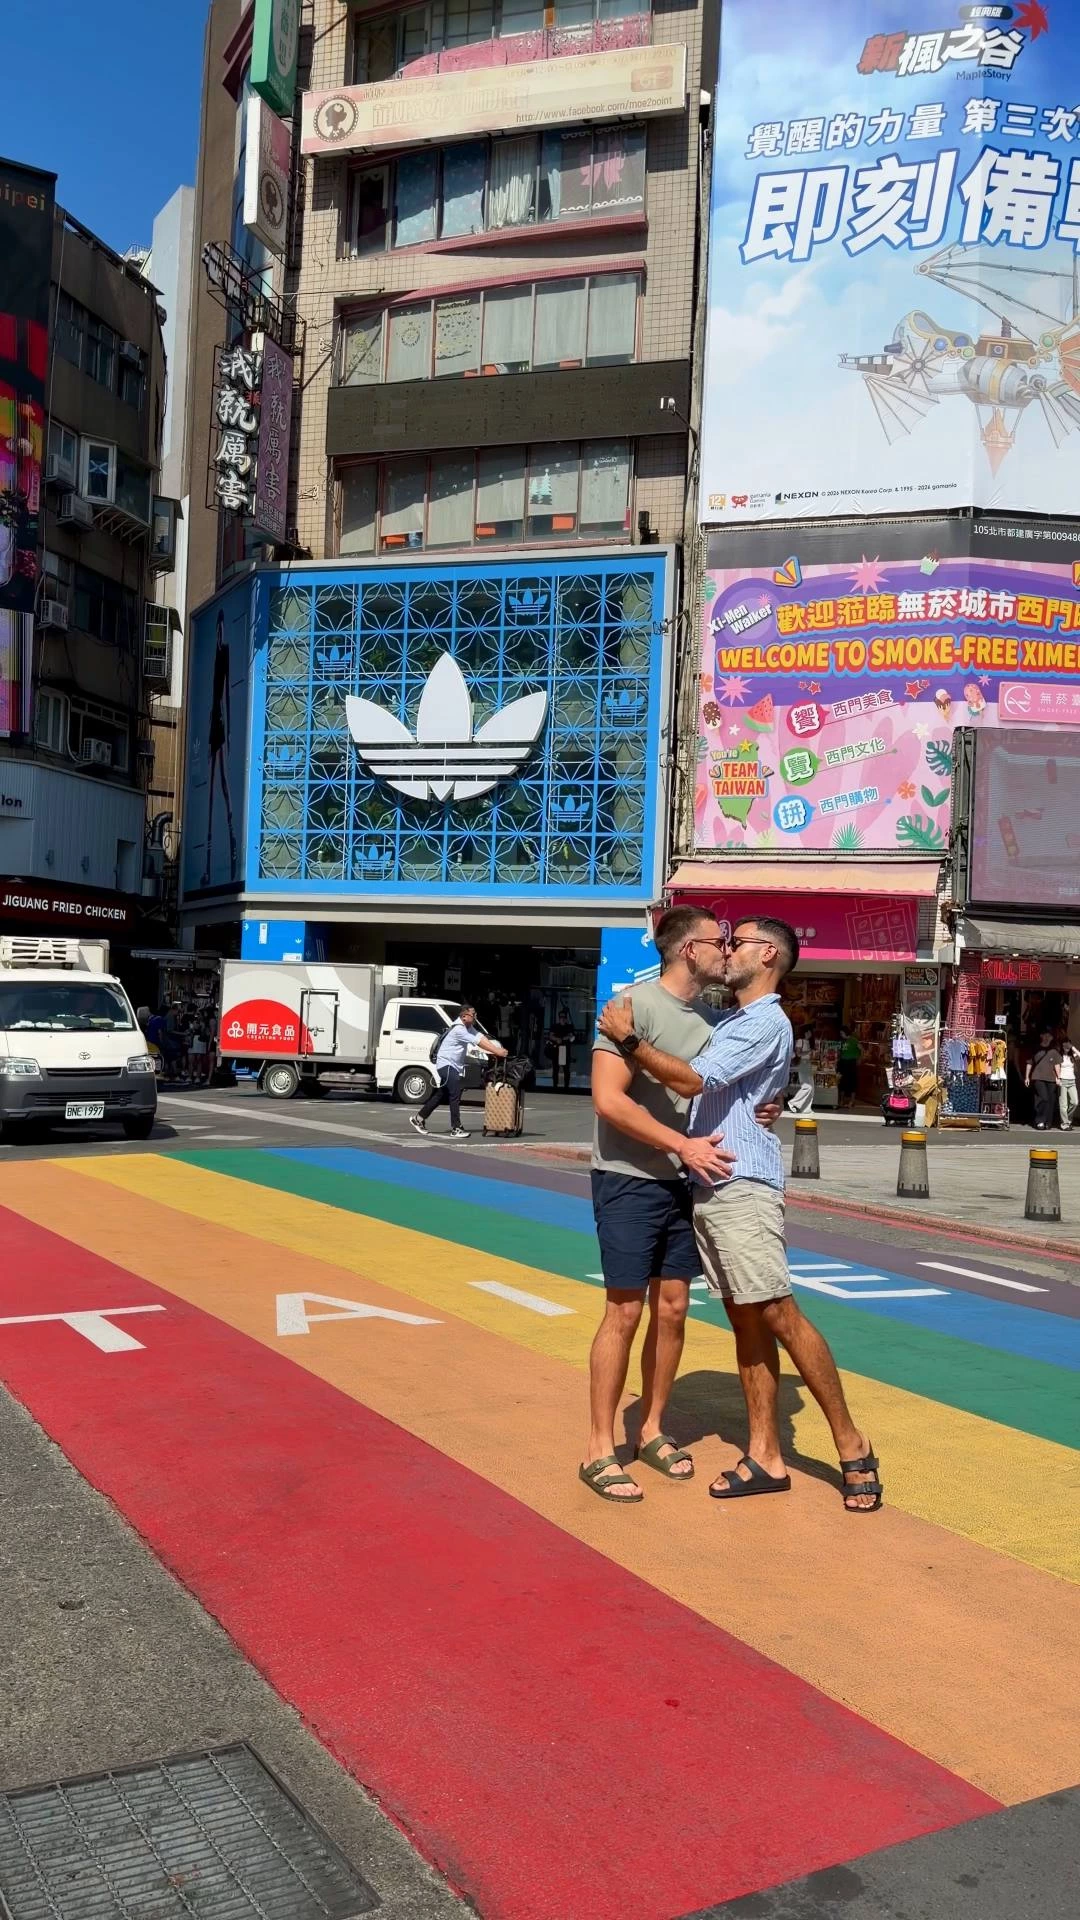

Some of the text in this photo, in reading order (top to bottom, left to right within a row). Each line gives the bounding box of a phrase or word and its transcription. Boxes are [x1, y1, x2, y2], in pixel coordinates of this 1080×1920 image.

[857, 23, 1024, 77] 新楓之谷
[956, 68, 1011, 82] MapleStory
[746, 97, 1080, 159] 覺醒的力量 第三次
[0, 184, 45, 211] ipei
[784, 491, 818, 500] NEXON
[840, 488, 860, 496] NEXON
[932, 482, 957, 490] gamania
[707, 604, 749, 635] Xi-Men
[730, 603, 773, 635] Walker
[721, 636, 1080, 669] WELCOME TO SMOKE-FREE XIME
[832, 690, 892, 718] 西門美食
[794, 706, 820, 731] 饗
[710, 748, 740, 762] You're
[824, 738, 885, 765] 西門文化
[722, 763, 759, 778] TEAM
[714, 780, 766, 797] TAIWAN
[819, 787, 878, 814] 西門購物
[780, 803, 803, 824] 拼
[3, 895, 126, 920] JIGUANG FRIED CHICKEN
[982, 959, 1042, 981] KILLER
[246, 1023, 294, 1037] 開元食品
